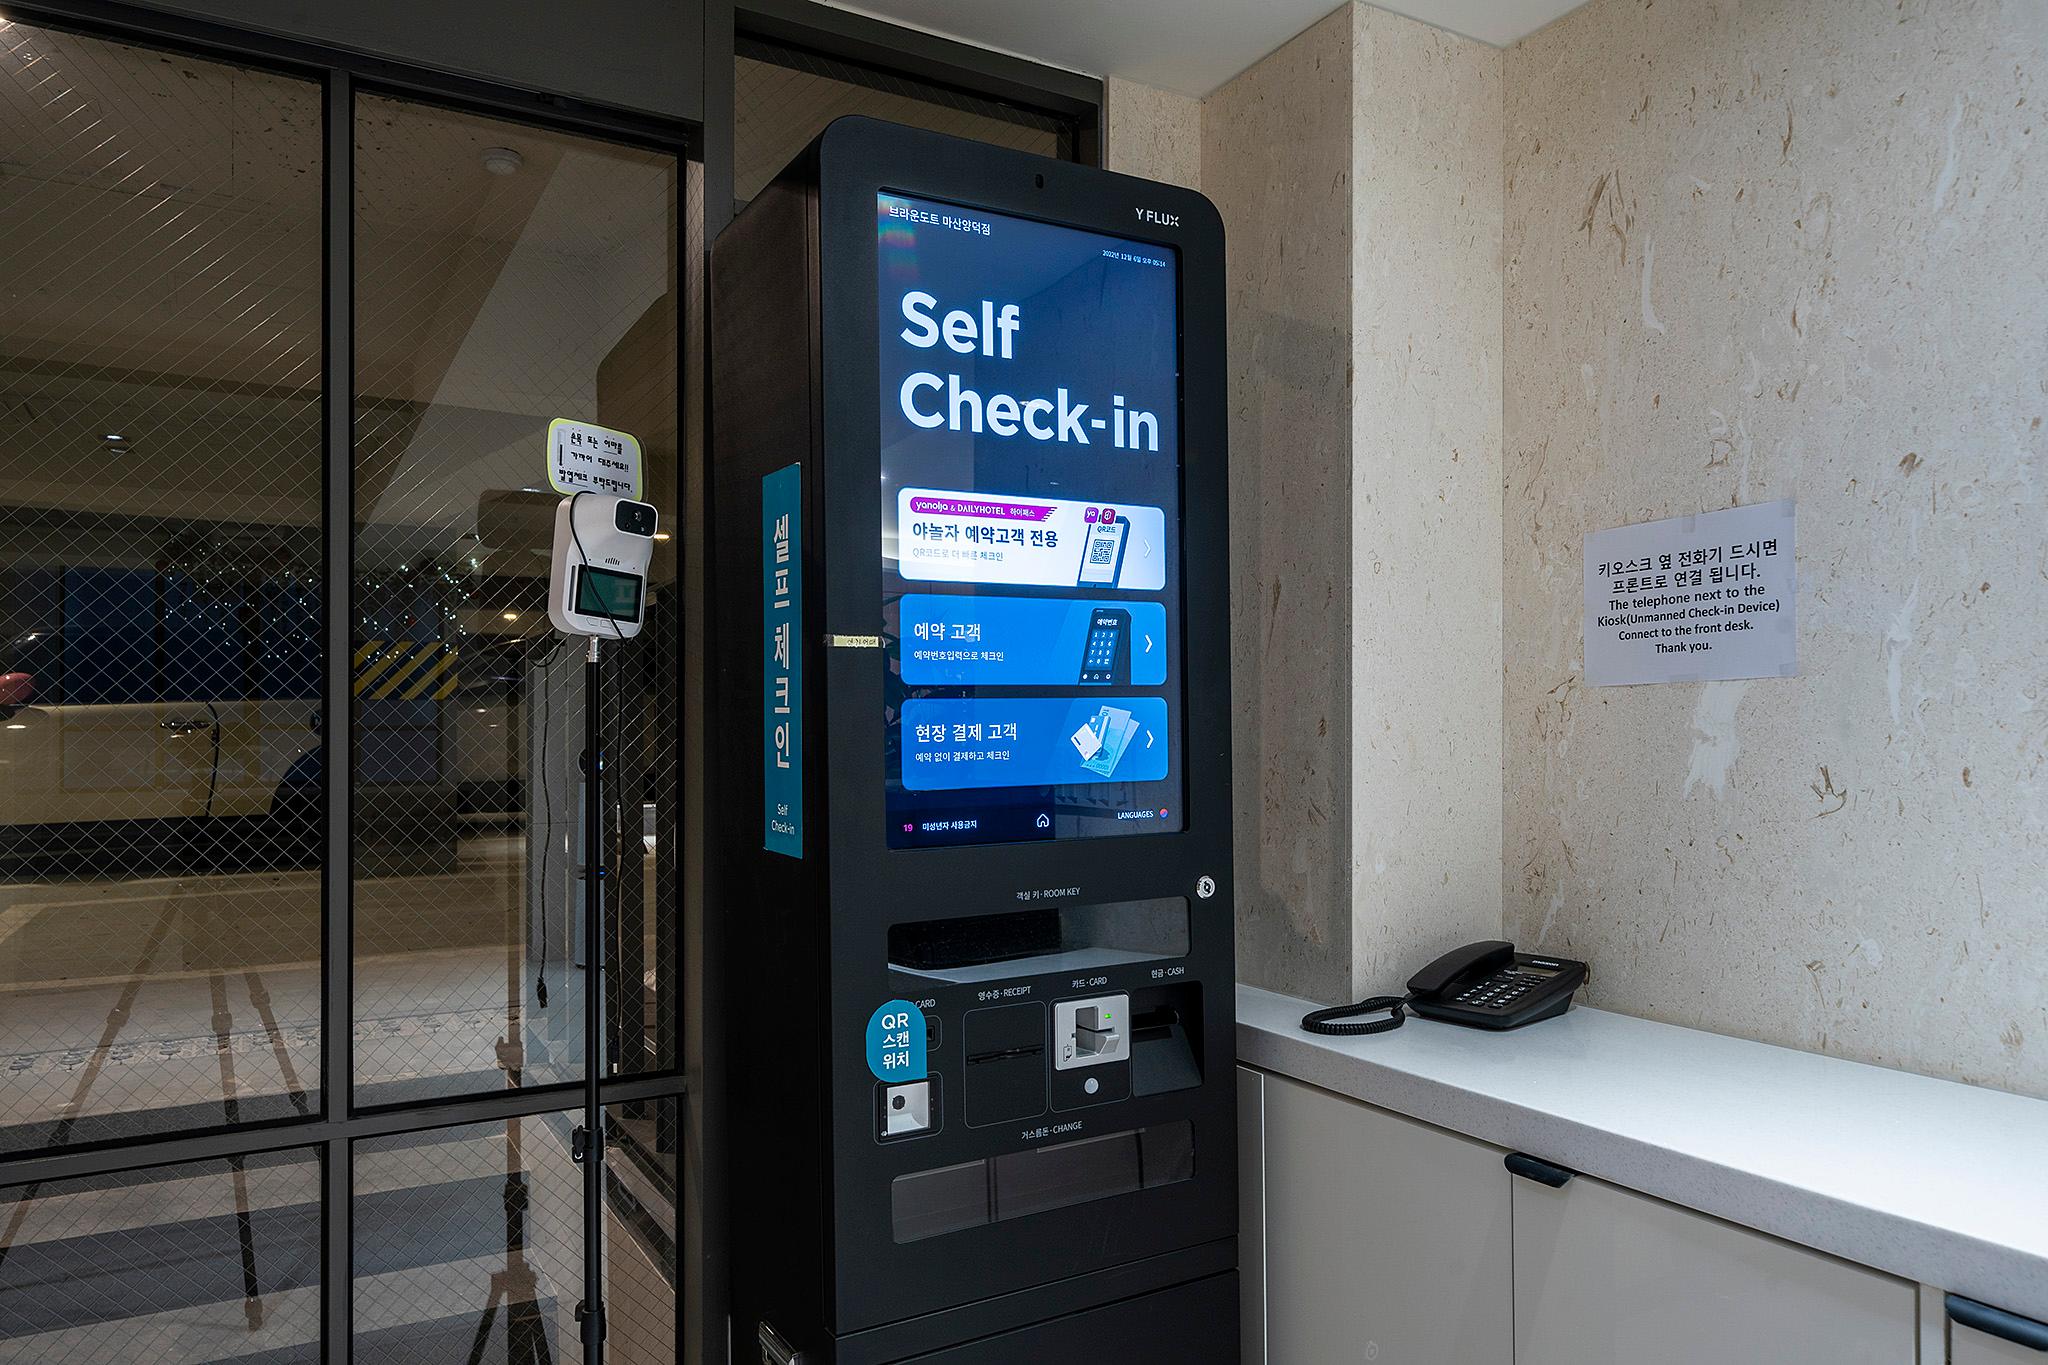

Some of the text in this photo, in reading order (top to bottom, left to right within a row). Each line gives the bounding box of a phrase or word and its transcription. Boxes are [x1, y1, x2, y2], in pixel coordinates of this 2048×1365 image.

[889, 206, 991, 236] 브라운도트 마산양덕점
[1135, 208, 1179, 227] Y FLUX
[900, 291, 1020, 359] Self
[899, 372, 1159, 452] Check-in
[570, 432, 623, 455] 손목 또는 이마를
[915, 501, 948, 512] yanolja
[957, 504, 1005, 516] DAILYHOTEL
[1010, 508, 1035, 517] 하이패스
[913, 522, 1058, 548] 야놀자 예약고객 전용
[980, 551, 1003, 561] 체크인
[1598, 539, 1778, 578] 키오스크 옆 전화기 드시면
[1612, 562, 1761, 594] 프론트로 연결 됩니다.
[1609, 584, 1765, 611] The telephone next to the
[1597, 599, 1780, 627] Kiosk(Unmanned Check-in Device)
[914, 622, 981, 641] 예약 고객
[1618, 619, 1753, 641] Connect to the front desk.
[914, 650, 1004, 661] 예약번호입력으로 체크인
[1655, 641, 1712, 654] Thank you.
[915, 723, 1017, 743] 현장 결제 고객
[915, 751, 1010, 762] 예약 없이 결제하고 체크인
[777, 803, 788, 816] Self
[1117, 810, 1154, 820] LANGUAGES
[771, 820, 795, 835] Check-in
[903, 820, 977, 832] 19 미성년자 사용금지
[1016, 891, 1030, 900] 객실
[1067, 887, 1081, 896] KEY
[915, 999, 936, 1008] CARD
[882, 1013, 908, 1030] QR
[883, 1031, 910, 1048] 스캔
[883, 1051, 909, 1069] 위치
